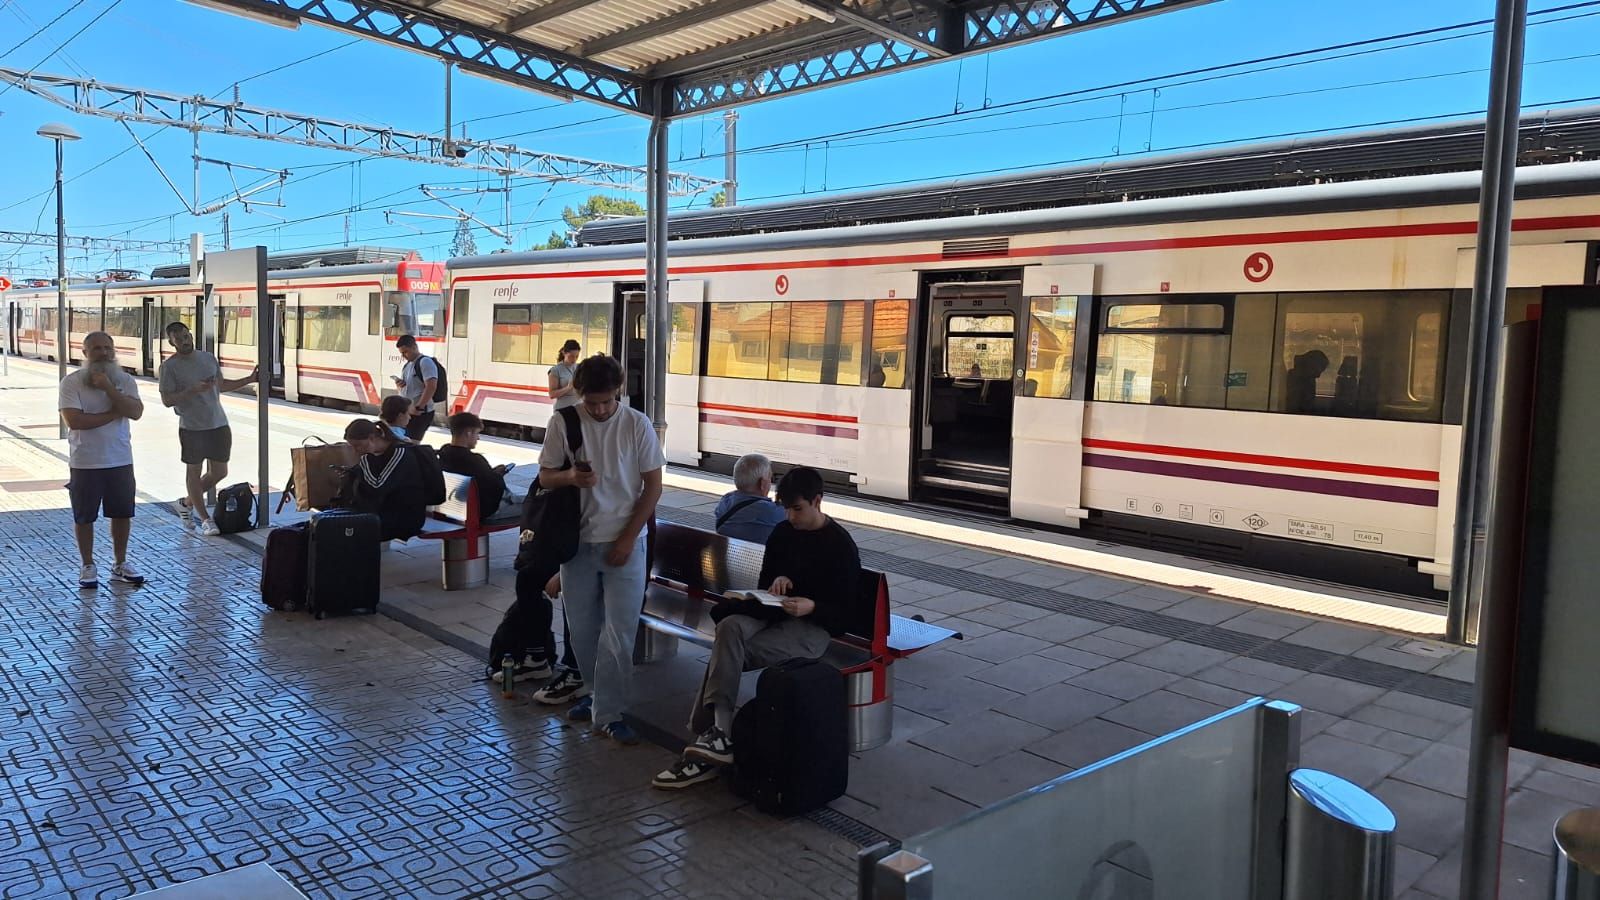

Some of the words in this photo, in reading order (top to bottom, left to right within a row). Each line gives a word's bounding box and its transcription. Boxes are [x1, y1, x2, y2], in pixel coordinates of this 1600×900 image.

[336, 288, 353, 304] renfe
[493, 282, 519, 301] renfe
[1249, 518, 1264, 527] 120
